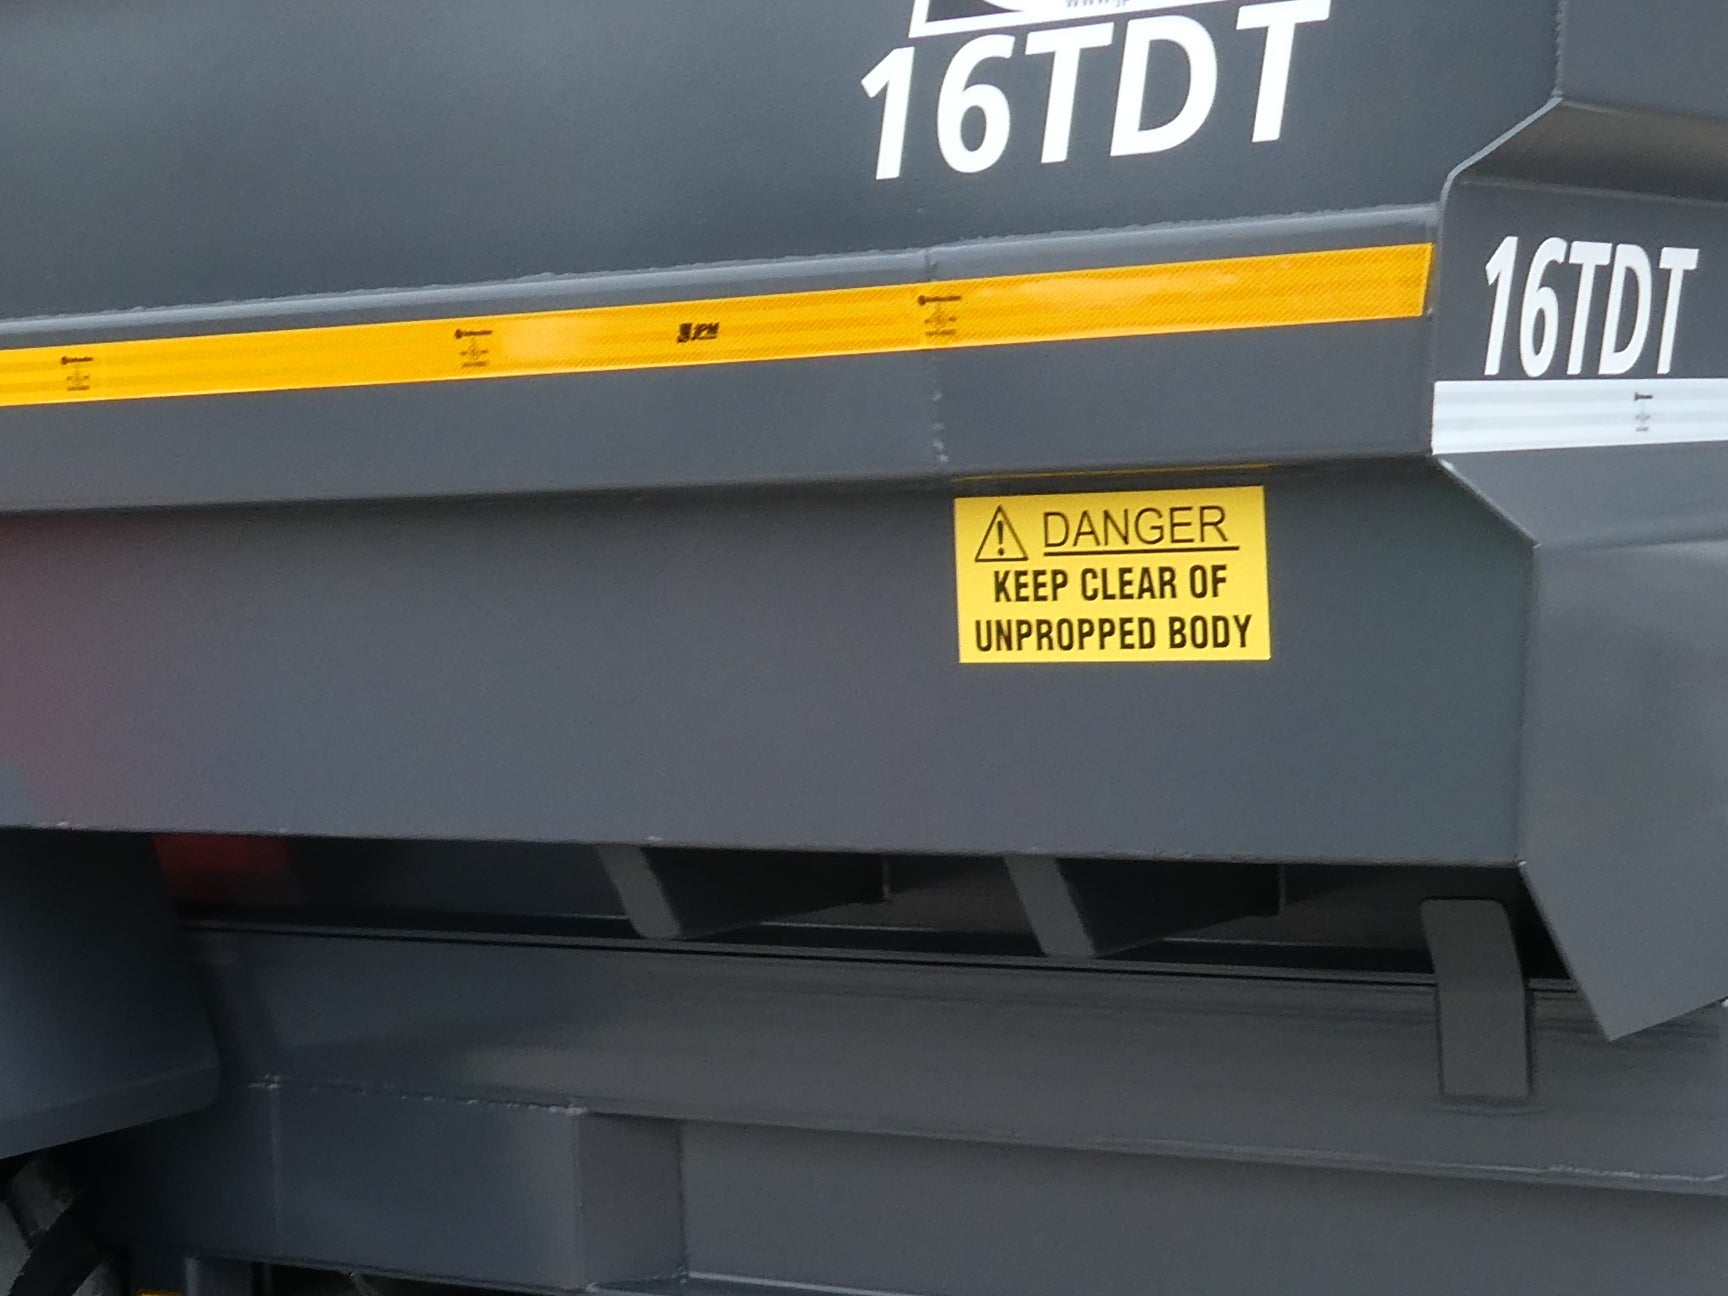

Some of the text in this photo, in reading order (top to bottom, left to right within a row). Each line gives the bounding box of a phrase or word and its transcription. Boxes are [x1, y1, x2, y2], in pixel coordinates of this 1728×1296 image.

[1483, 235, 1700, 378] 16TDT
[1043, 505, 1228, 548] DANGER
[993, 564, 1228, 603] KEEP CLEAR OF
[974, 614, 1253, 653] UNPROPPED BODY
